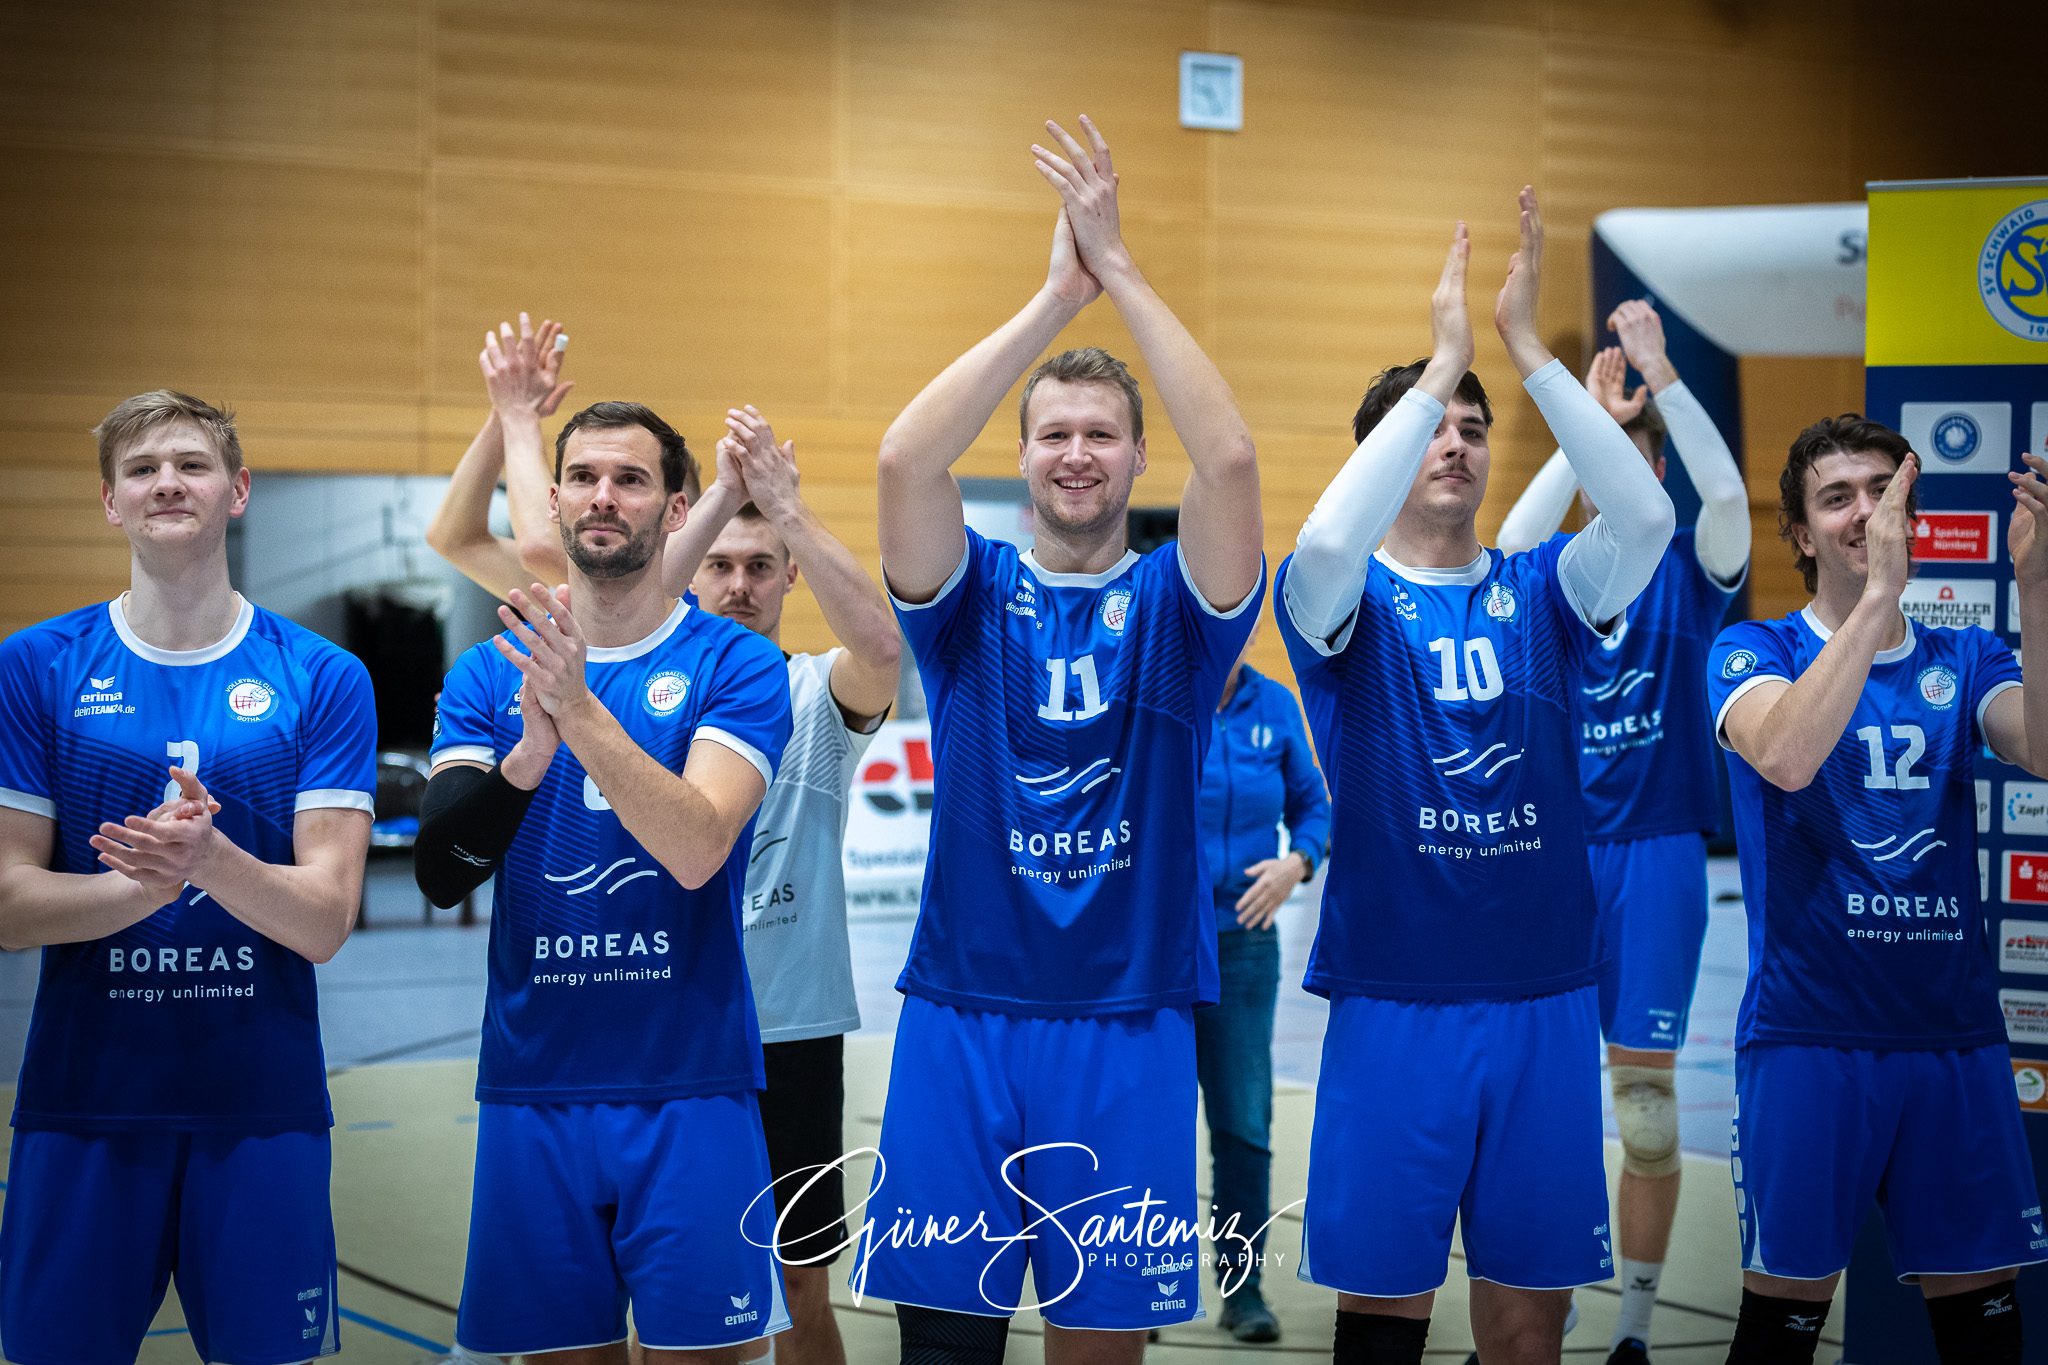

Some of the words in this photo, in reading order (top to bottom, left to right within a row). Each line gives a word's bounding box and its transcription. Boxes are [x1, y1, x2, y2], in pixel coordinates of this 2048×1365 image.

[1984, 209, 2035, 270] SCHWAIG
[1984, 276, 1997, 296] SV
[1933, 526, 1981, 539] Sparkasse
[1933, 540, 1977, 553] Nürnberg
[1428, 637, 1504, 701] 10
[1944, 669, 1957, 680] CLUB
[225, 678, 263, 693] VOLLEYBALL
[645, 671, 680, 688] VOLLEYBALL
[680, 674, 691, 687] CLUB
[1038, 654, 1109, 721] 11
[81, 691, 122, 703] erima
[262, 682, 276, 696] CLUB
[74, 704, 135, 717] deinTEAM24.de
[654, 709, 675, 717] GOTHA
[1932, 703, 1953, 711] GOTHA
[237, 715, 260, 723] GOTHA
[1856, 724, 1930, 790] 12
[1419, 803, 1537, 834] BOREAS
[2018, 805, 2044, 817] Zapf
[1009, 820, 1131, 857] BOREAS
[1418, 844, 1472, 859] energy
[1480, 837, 1541, 856] unlimited
[1011, 865, 1061, 883] energy
[1068, 854, 1131, 879] unlimited
[1847, 893, 1959, 918] BOREAS
[1847, 928, 1901, 943] energy
[1907, 928, 1964, 941] unlimited
[535, 930, 670, 959] BOREAS
[109, 946, 254, 972] BOREAS
[534, 972, 586, 985] energy
[594, 966, 671, 982] unlimited
[109, 988, 165, 1002] energy
[173, 983, 254, 998] unlimited
[1151, 1299, 1187, 1311] erima
[724, 1310, 758, 1326] erima
